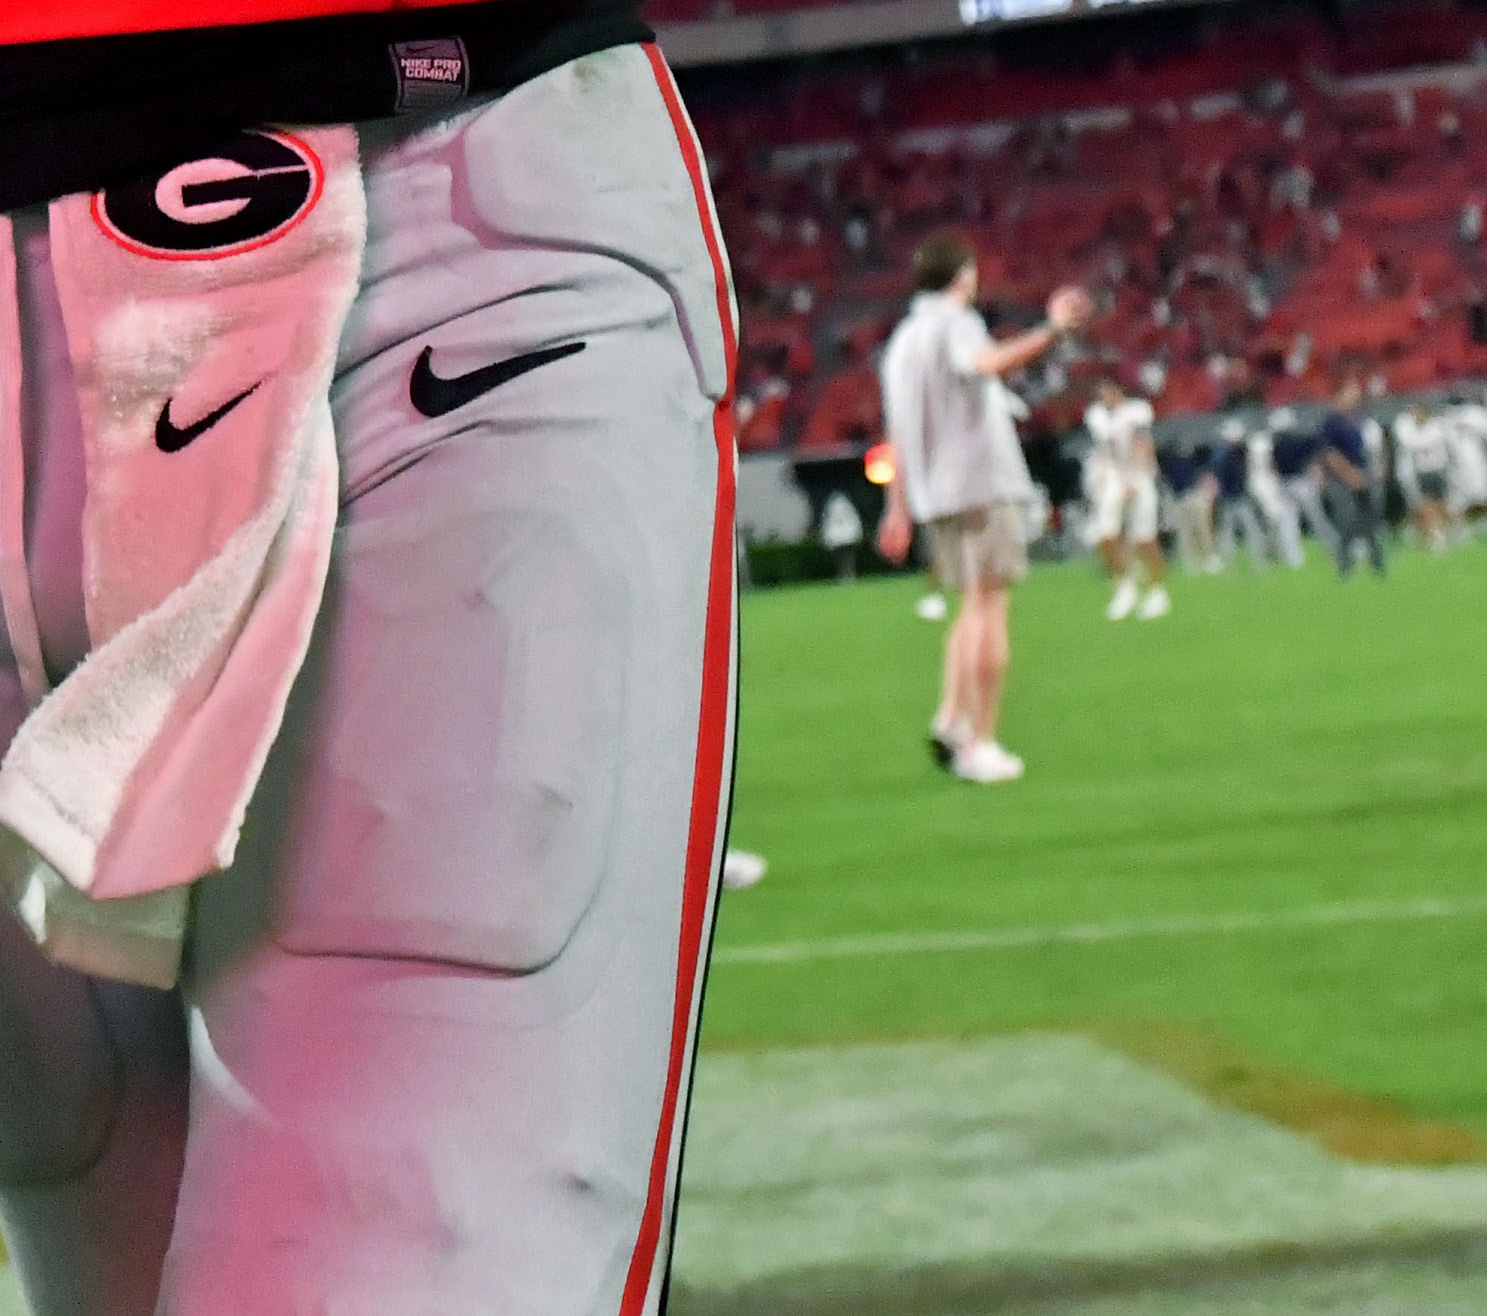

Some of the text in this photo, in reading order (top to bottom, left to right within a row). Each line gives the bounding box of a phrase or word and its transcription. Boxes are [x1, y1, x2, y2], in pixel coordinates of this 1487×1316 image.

[400, 58, 462, 73] NIKE PRO
[405, 67, 460, 82] COMBAT
[98, 127, 315, 251] G
